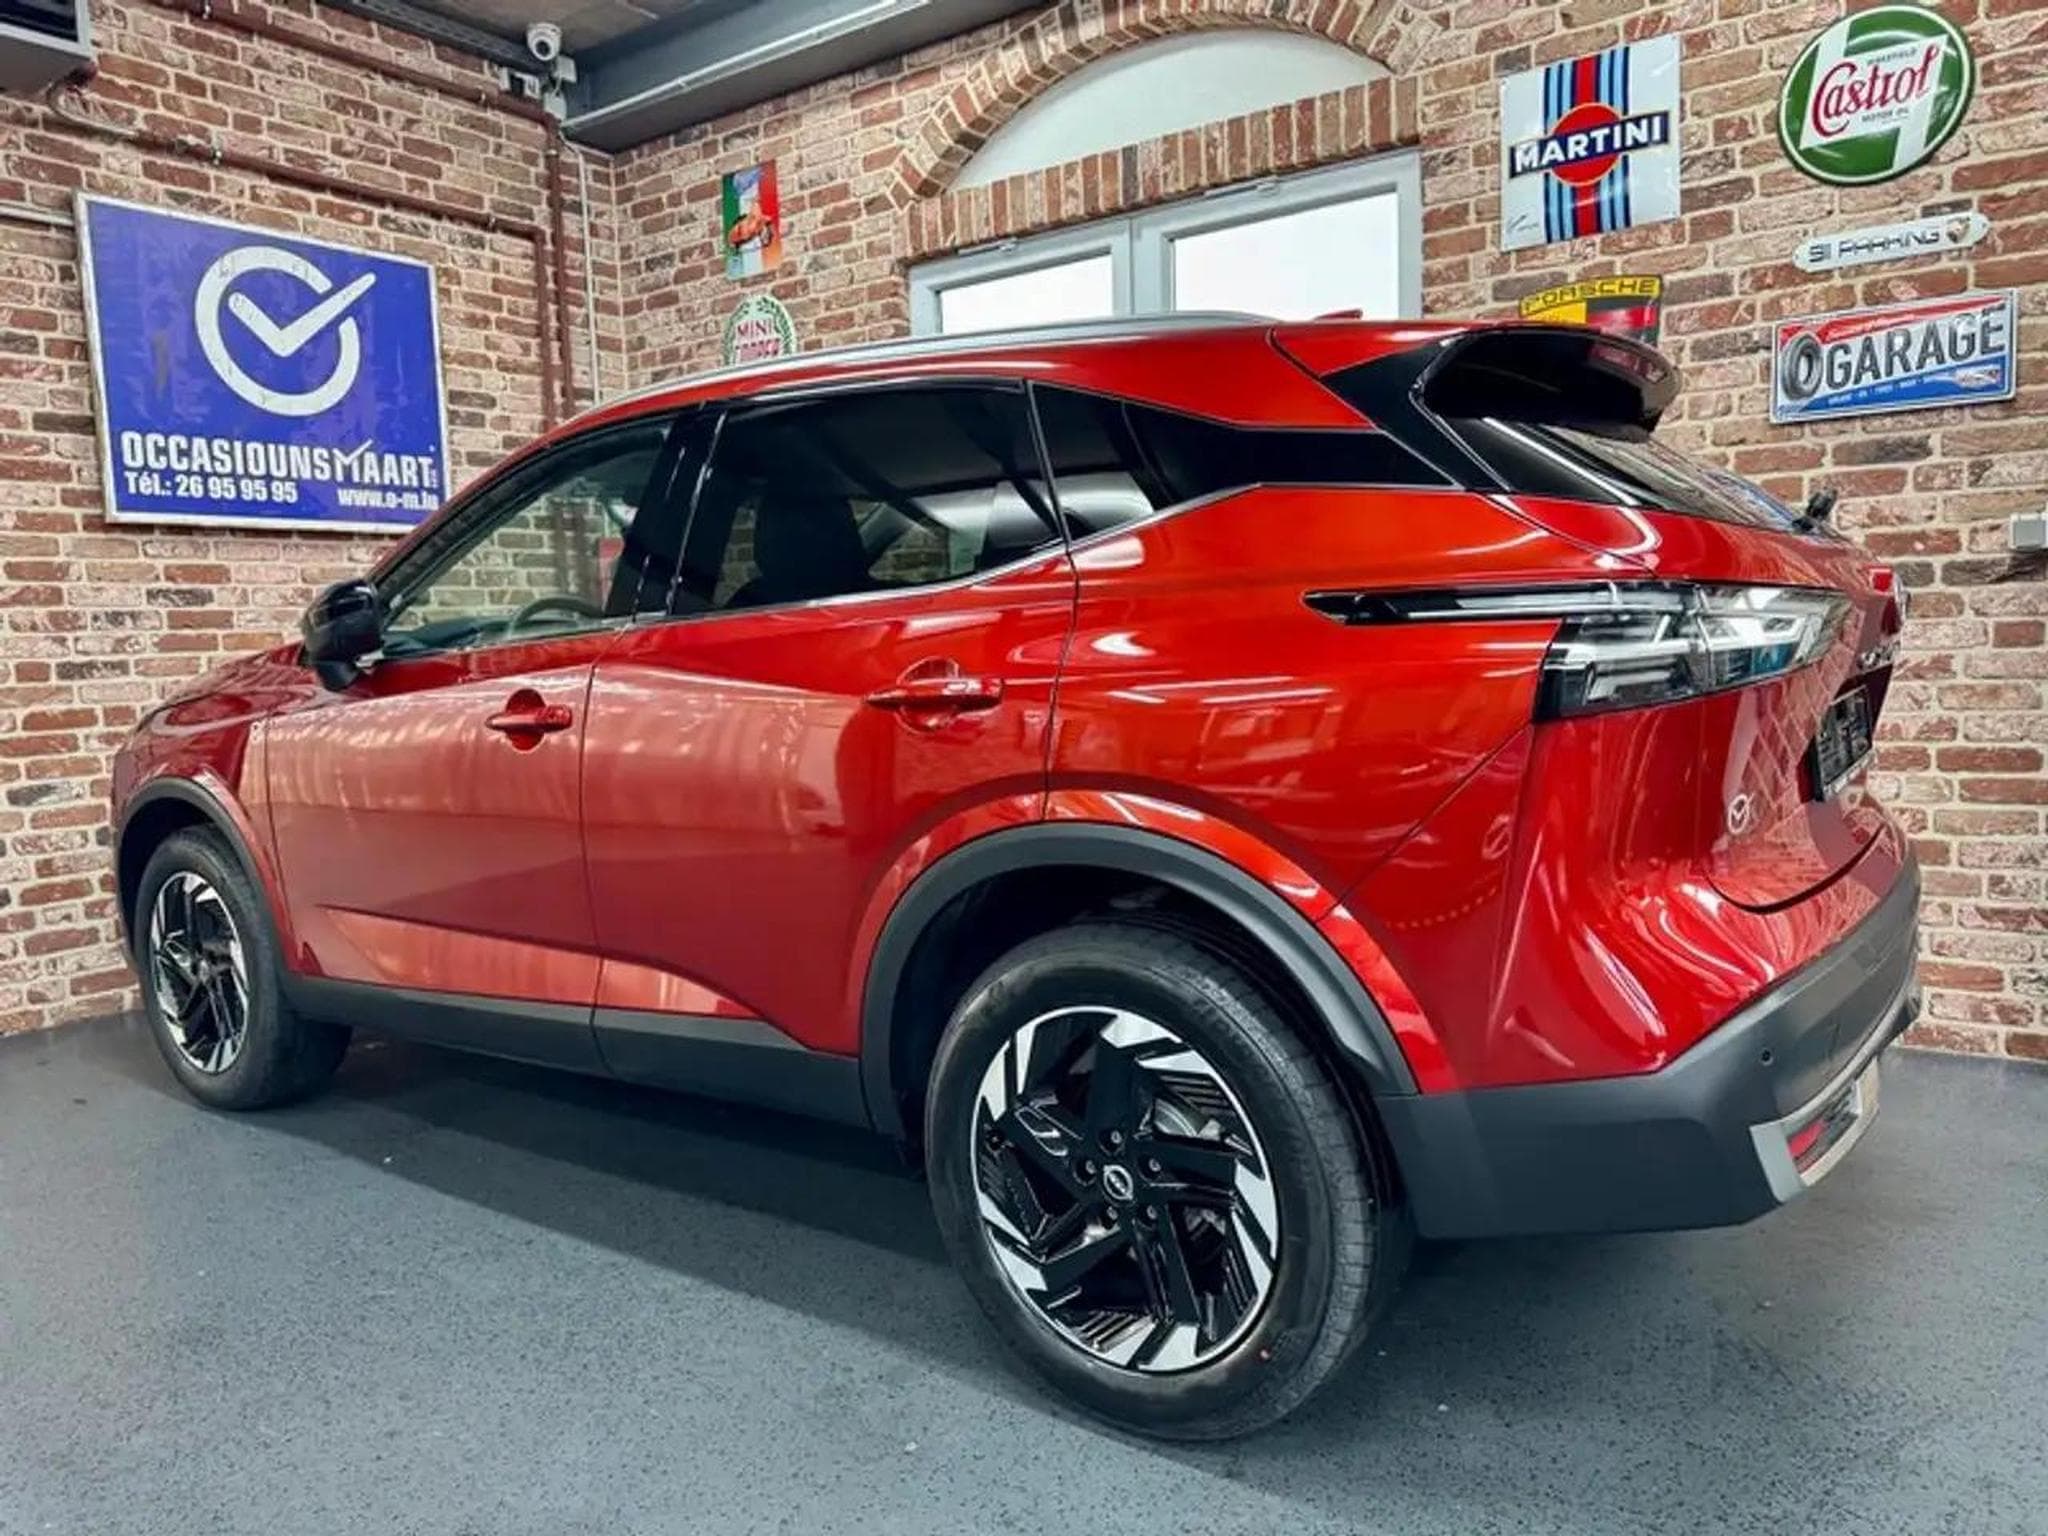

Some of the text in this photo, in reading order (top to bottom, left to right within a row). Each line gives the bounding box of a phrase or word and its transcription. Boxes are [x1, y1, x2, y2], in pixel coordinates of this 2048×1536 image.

[1812, 43, 1940, 138] Castrol
[1514, 115, 1662, 174] MARTINI
[1839, 230, 1941, 259] PARKING
[1526, 278, 1657, 312] PORSCHE
[736, 318, 772, 338] MINI
[1826, 302, 2006, 391] GARAGE
[121, 430, 434, 489] OCCASIOUNSMAART
[124, 471, 299, 504] Tél.: 26 95 95 95
